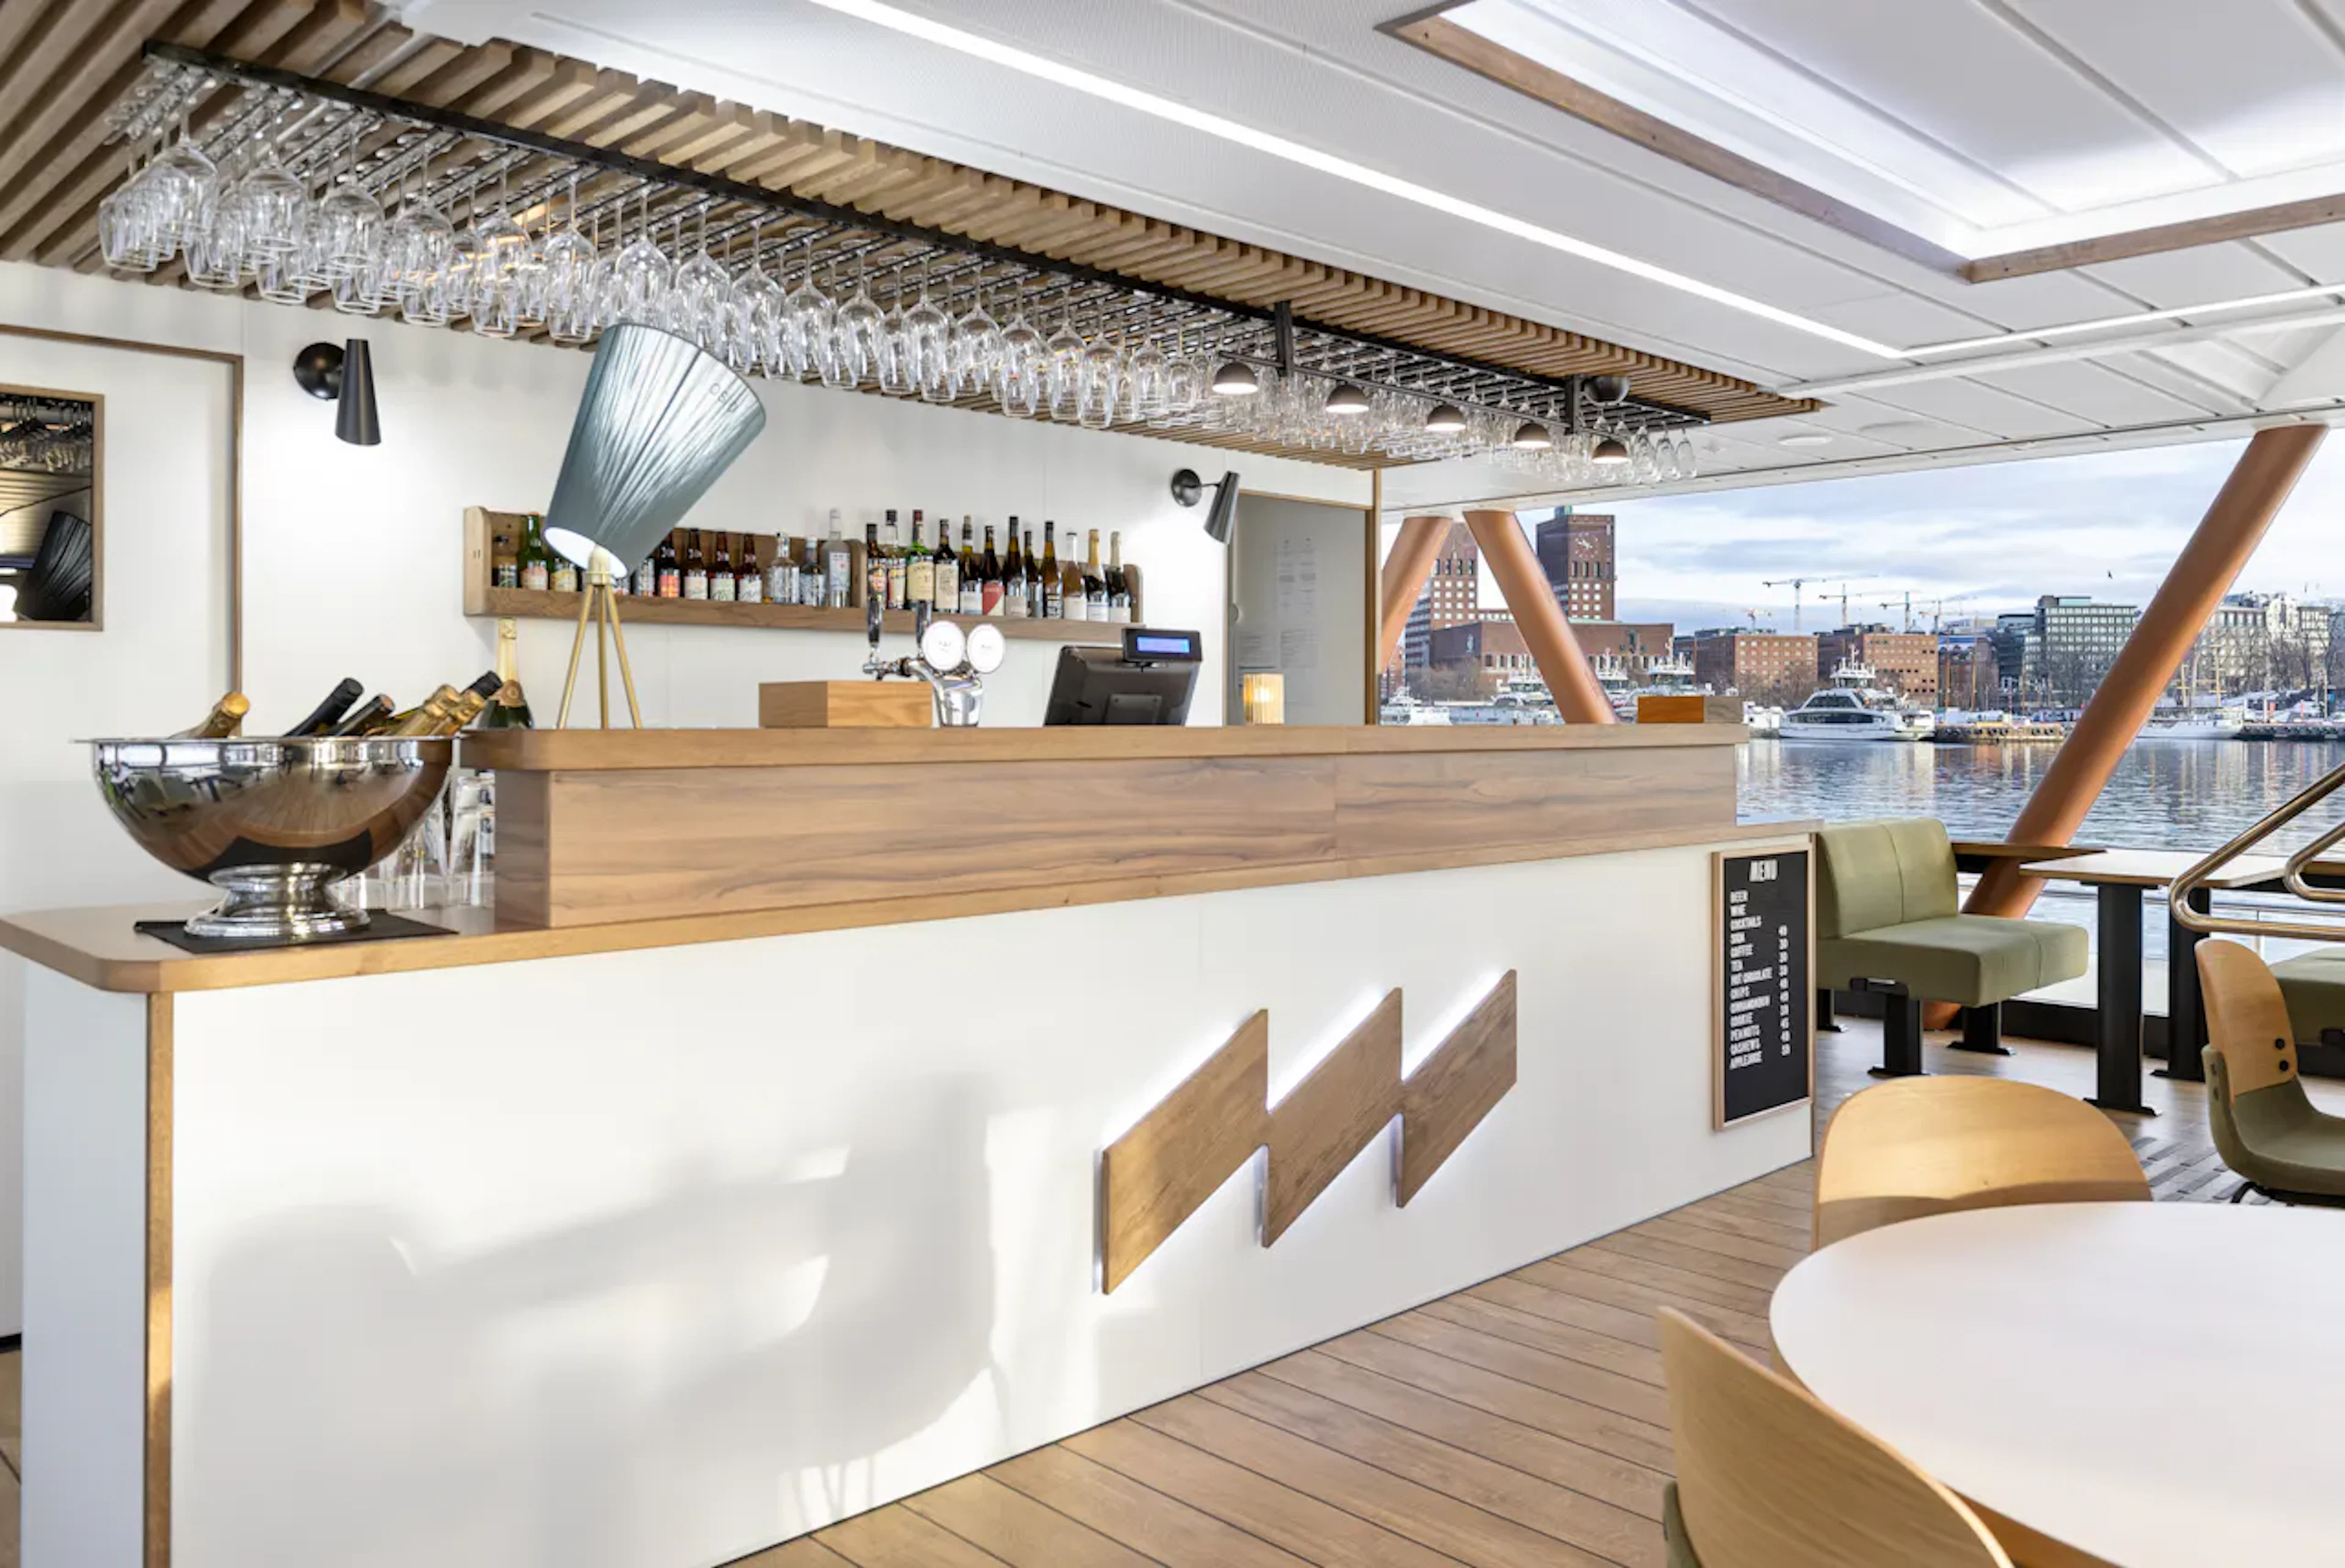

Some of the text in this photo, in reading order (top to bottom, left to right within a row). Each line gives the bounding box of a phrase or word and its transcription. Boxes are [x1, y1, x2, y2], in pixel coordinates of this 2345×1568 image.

[1749, 858, 1778, 882] MENU
[1730, 890, 1748, 904] BEER
[1730, 1025, 1760, 1041] PEANUTS
